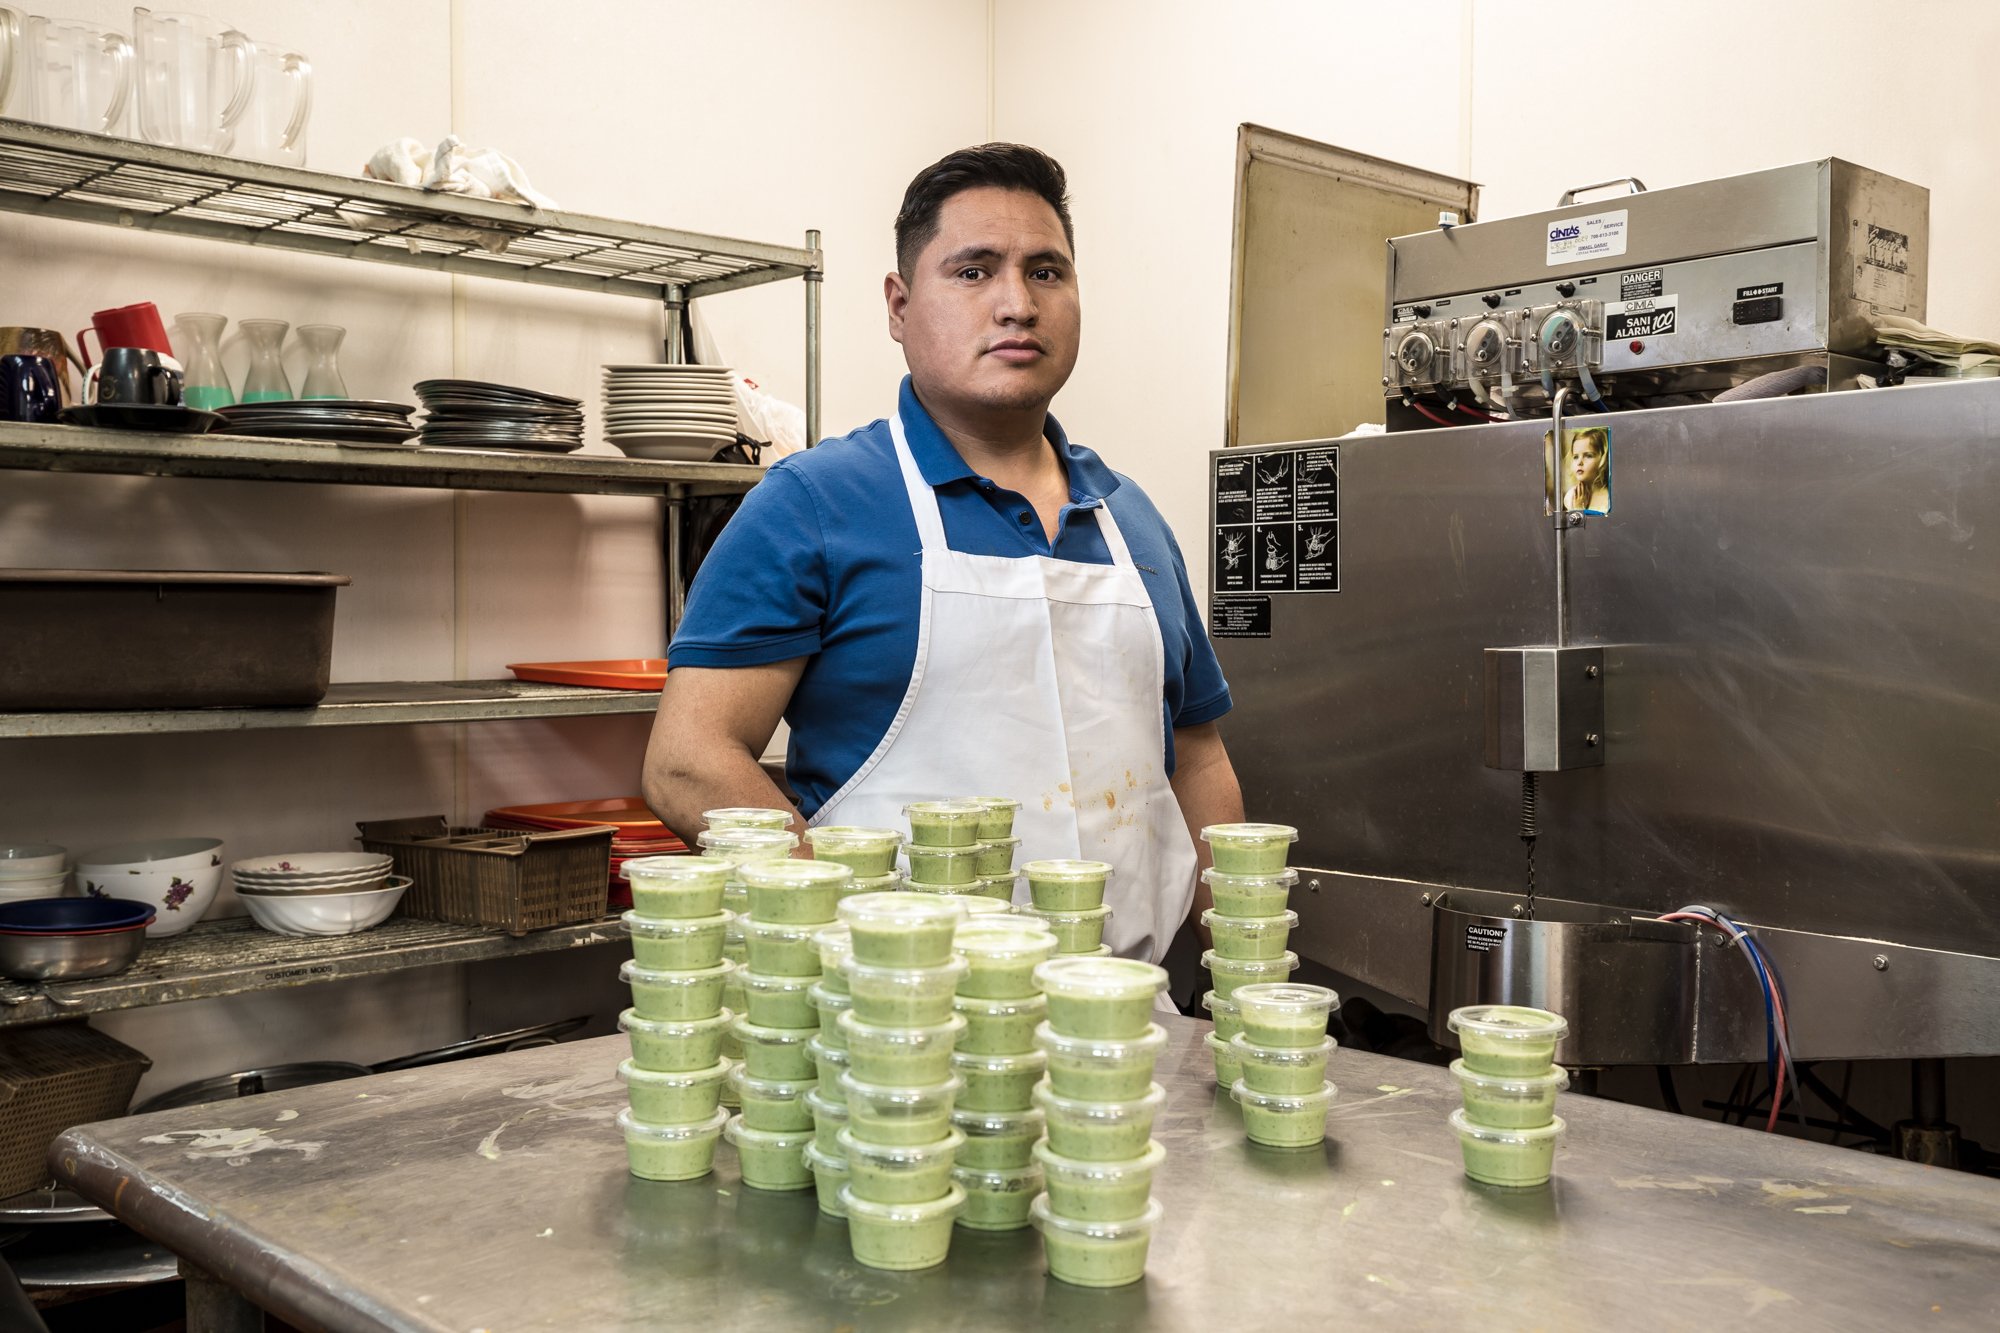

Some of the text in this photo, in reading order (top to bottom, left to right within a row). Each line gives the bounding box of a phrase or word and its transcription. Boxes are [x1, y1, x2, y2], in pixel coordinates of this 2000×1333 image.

[1603, 221, 1624, 230] SERVICE
[1549, 225, 1580, 240] CINTAS
[1623, 270, 1661, 284] DANGER
[1626, 315, 1651, 328] SANI
[1652, 310, 1674, 331] 100
[1615, 325, 1651, 338] ALARM
[265, 968, 308, 981] CUSTOMER
